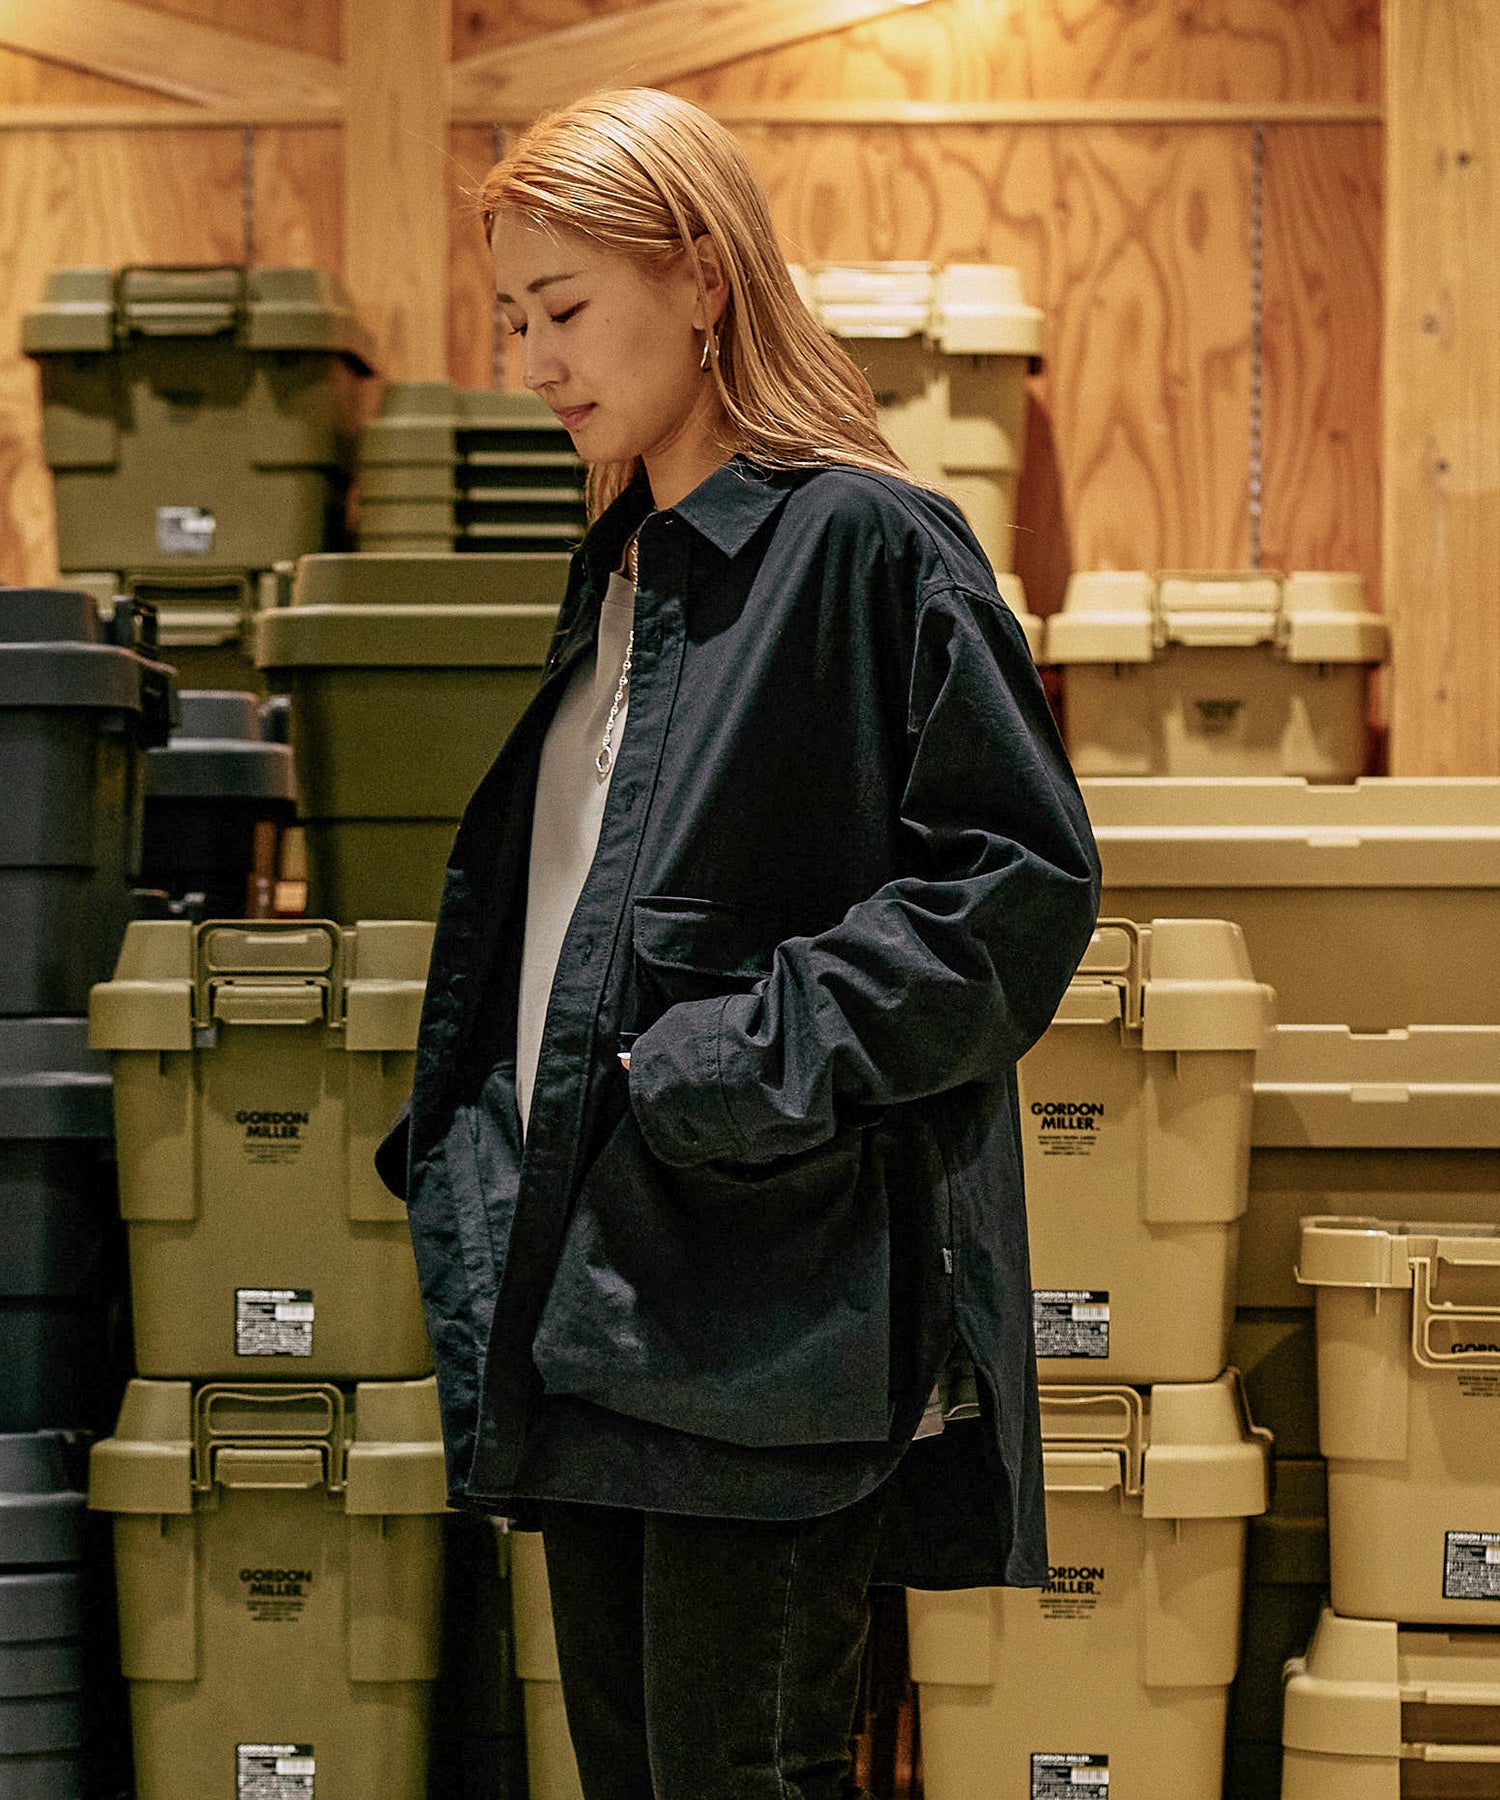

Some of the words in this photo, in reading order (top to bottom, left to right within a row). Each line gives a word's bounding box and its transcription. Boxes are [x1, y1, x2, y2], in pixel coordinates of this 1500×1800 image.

[1031, 1102, 1104, 1115] GORDON
[236, 1111, 309, 1124] GORDON
[1451, 1343, 1500, 1354] GORD
[239, 1569, 312, 1582] GORDON
[1046, 1566, 1104, 1580] ORDON
